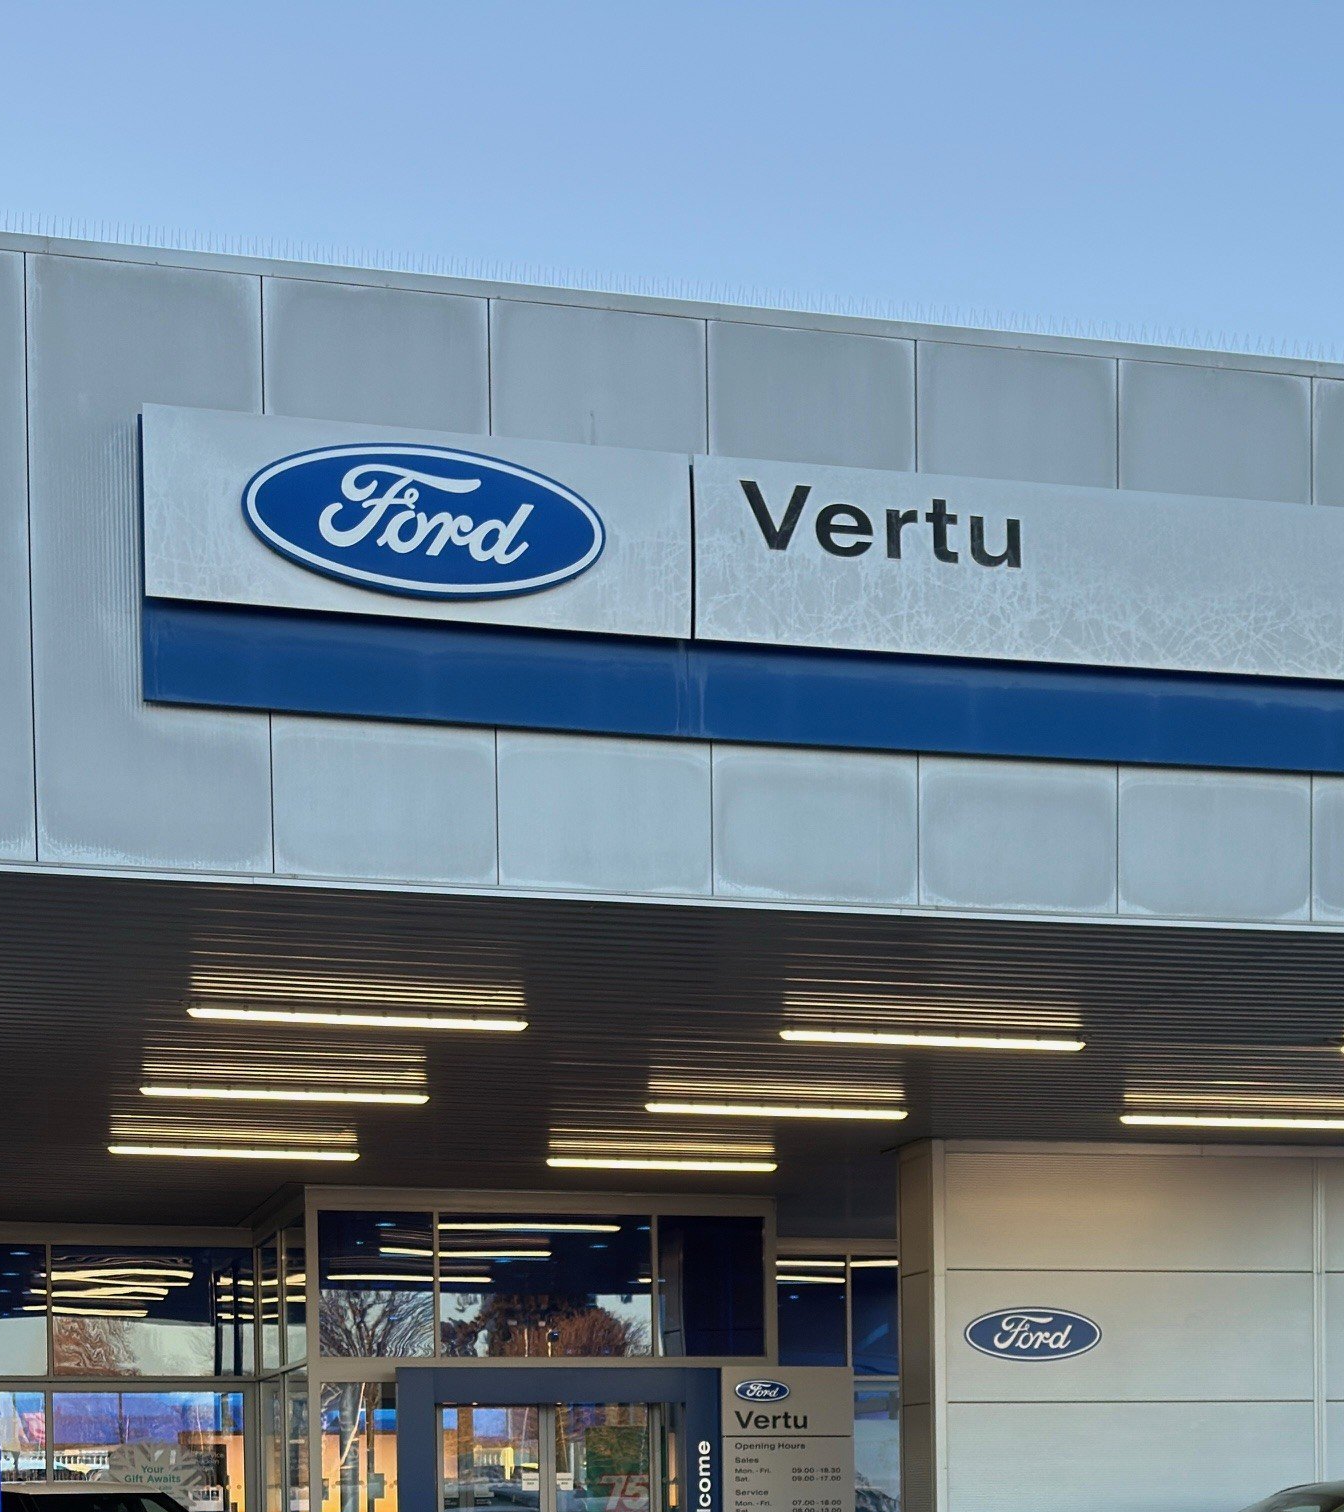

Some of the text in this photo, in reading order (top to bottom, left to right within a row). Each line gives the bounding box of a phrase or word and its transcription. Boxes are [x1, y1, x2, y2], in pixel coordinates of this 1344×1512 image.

[319, 464, 535, 565] Ford
[739, 479, 1023, 570] Vertu
[994, 1315, 1073, 1350] Ford
[746, 1381, 779, 1398] Ford
[734, 1410, 809, 1430] Vertu
[734, 1443, 776, 1451] Opening
[124, 1474, 181, 1483] Gift Awaits
[141, 1465, 164, 1474] Your
[600, 1475, 650, 1510] 75
